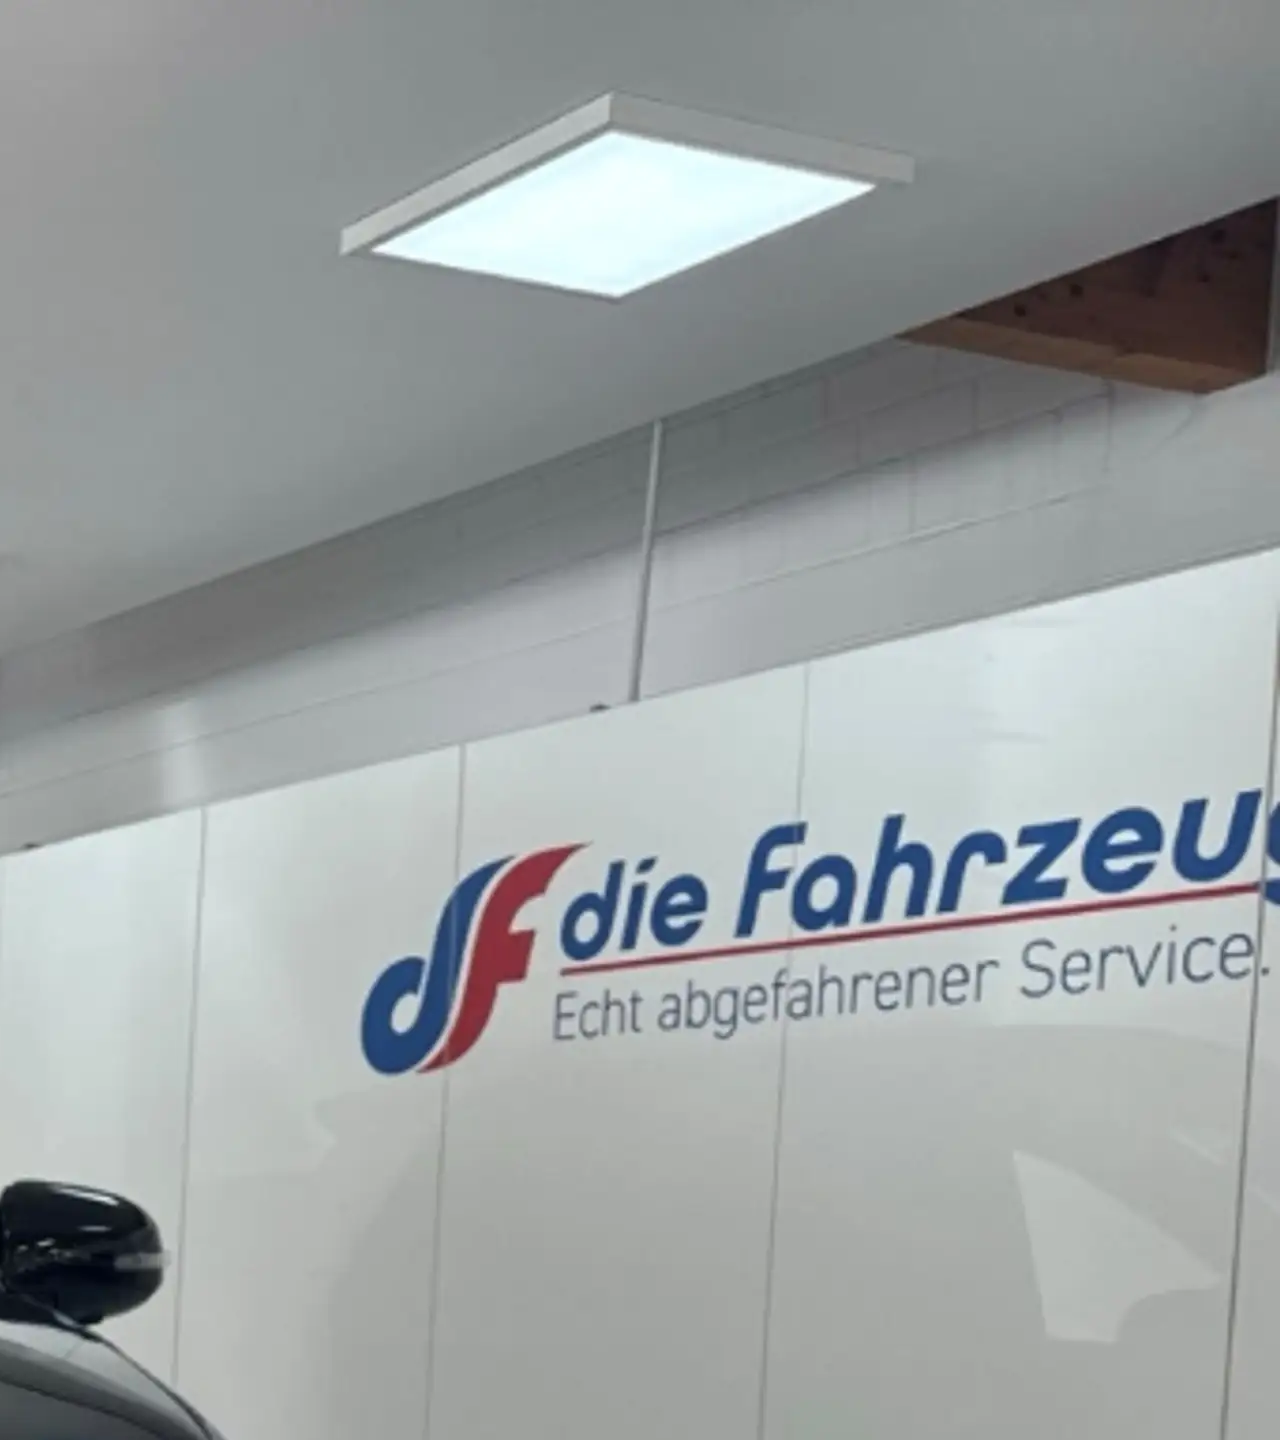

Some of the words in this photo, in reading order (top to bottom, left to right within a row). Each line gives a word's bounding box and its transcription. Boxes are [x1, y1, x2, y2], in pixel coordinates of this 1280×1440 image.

[561, 856, 708, 961] die
[734, 788, 1280, 938] Fahrzeu
[552, 988, 644, 1041] Echt
[656, 956, 1001, 1041] abgefahrener
[1019, 923, 1271, 999] Service.
